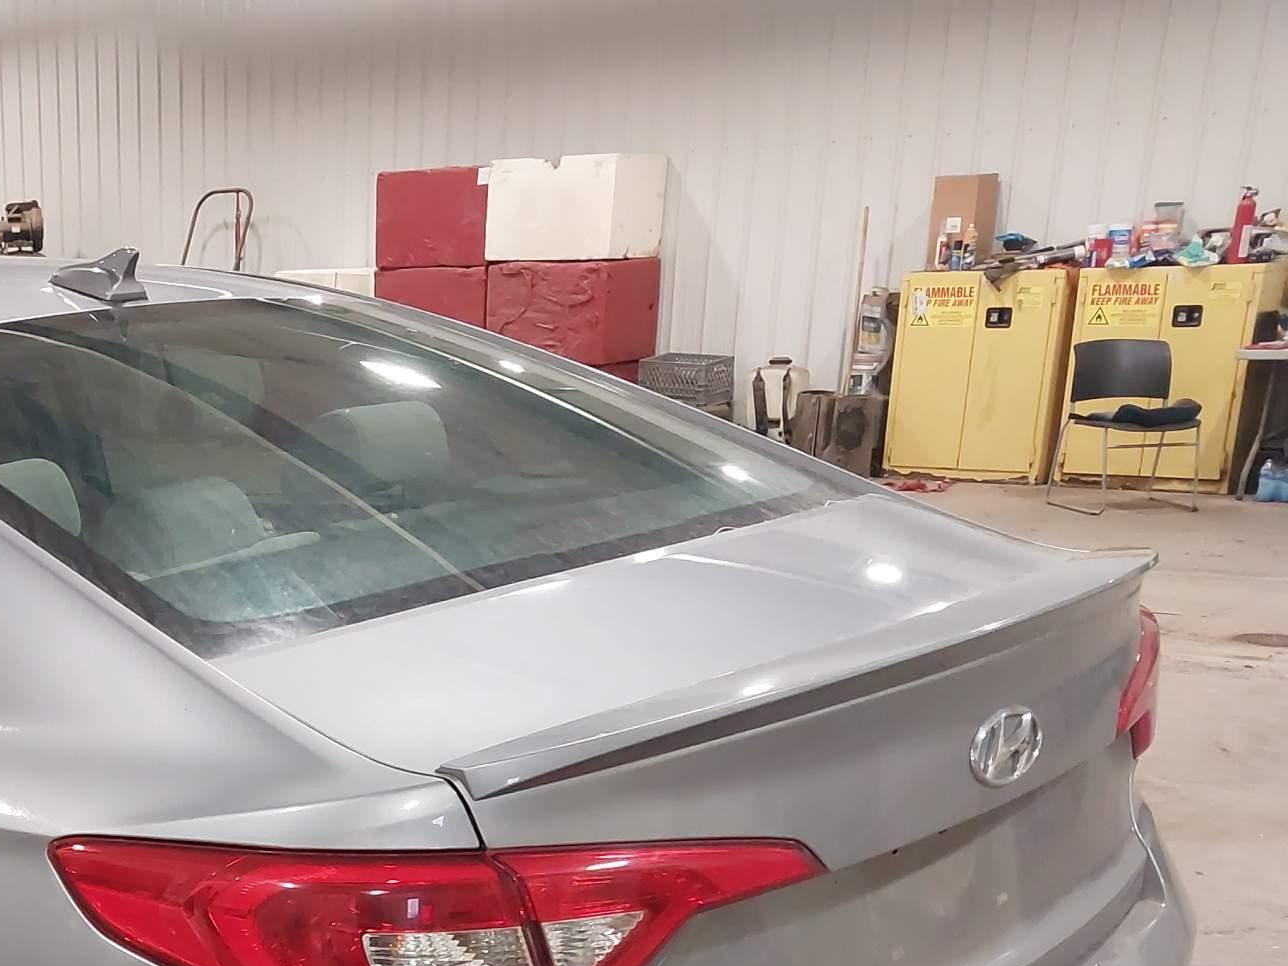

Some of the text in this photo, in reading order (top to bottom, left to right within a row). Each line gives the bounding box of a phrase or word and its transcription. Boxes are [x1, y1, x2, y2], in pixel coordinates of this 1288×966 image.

[914, 286, 975, 299] AMMABLE
[1092, 283, 1160, 297] FLAMMABLE
[932, 299, 951, 308] FIRE
[952, 299, 975, 307] AWAY
[1090, 297, 1159, 306] KEEP FIRE AWAY
